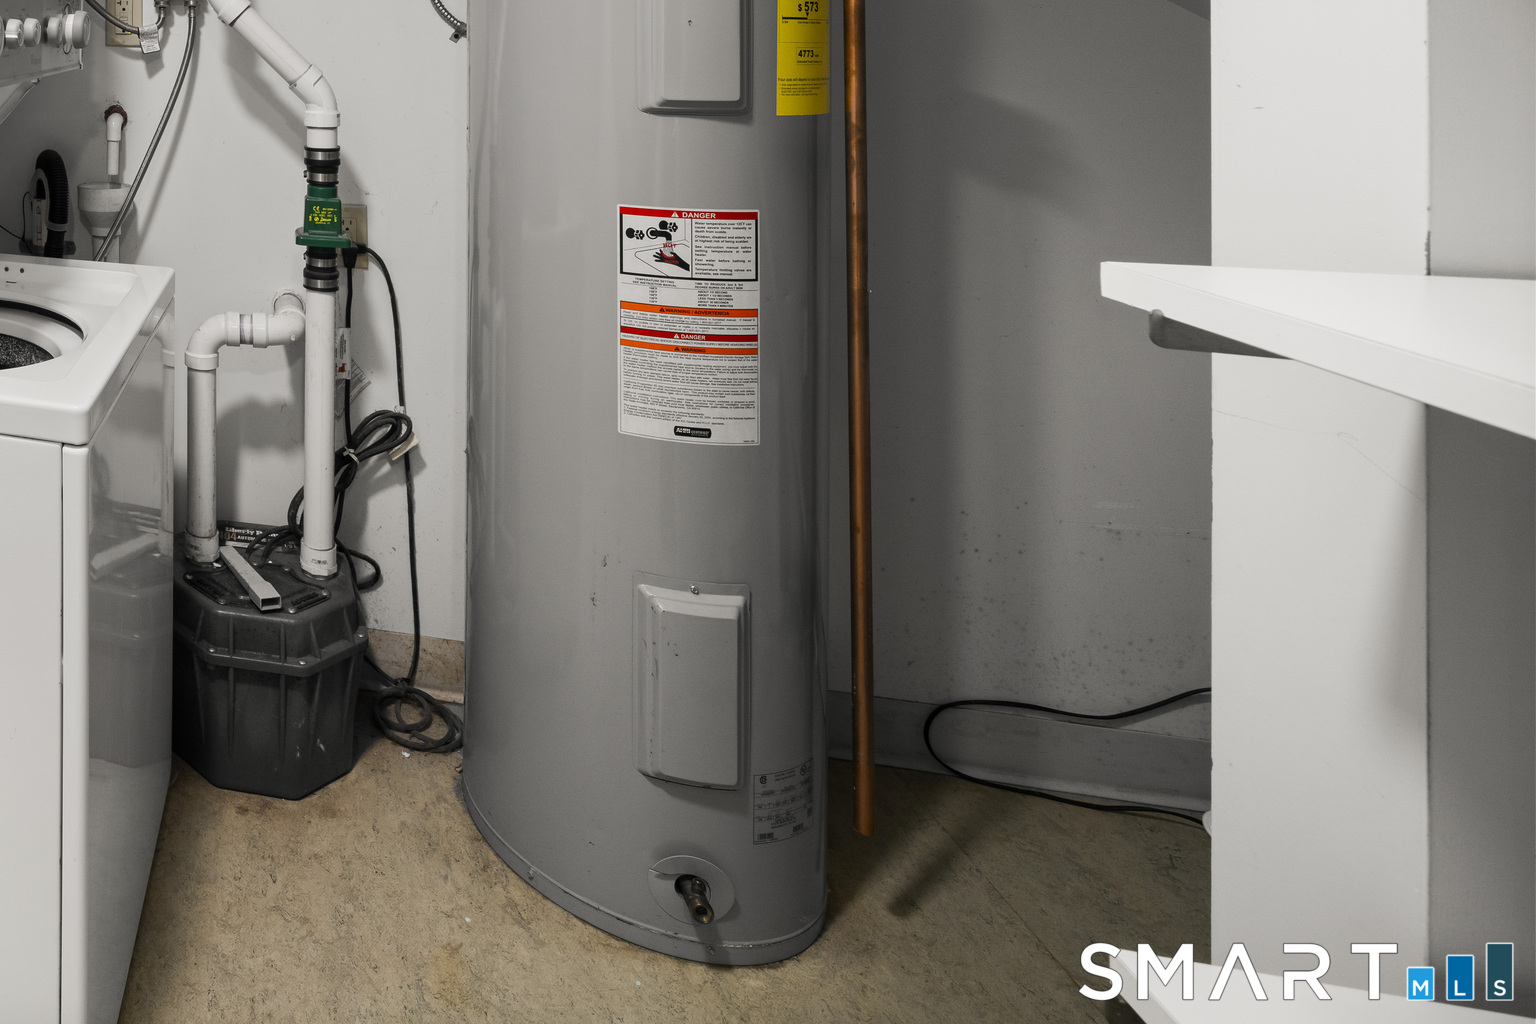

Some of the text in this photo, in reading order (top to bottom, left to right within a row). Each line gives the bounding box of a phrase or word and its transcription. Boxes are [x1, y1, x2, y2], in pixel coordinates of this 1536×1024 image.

[798, 1, 819, 12] $ 573
[225, 527, 254, 535] Liberty
